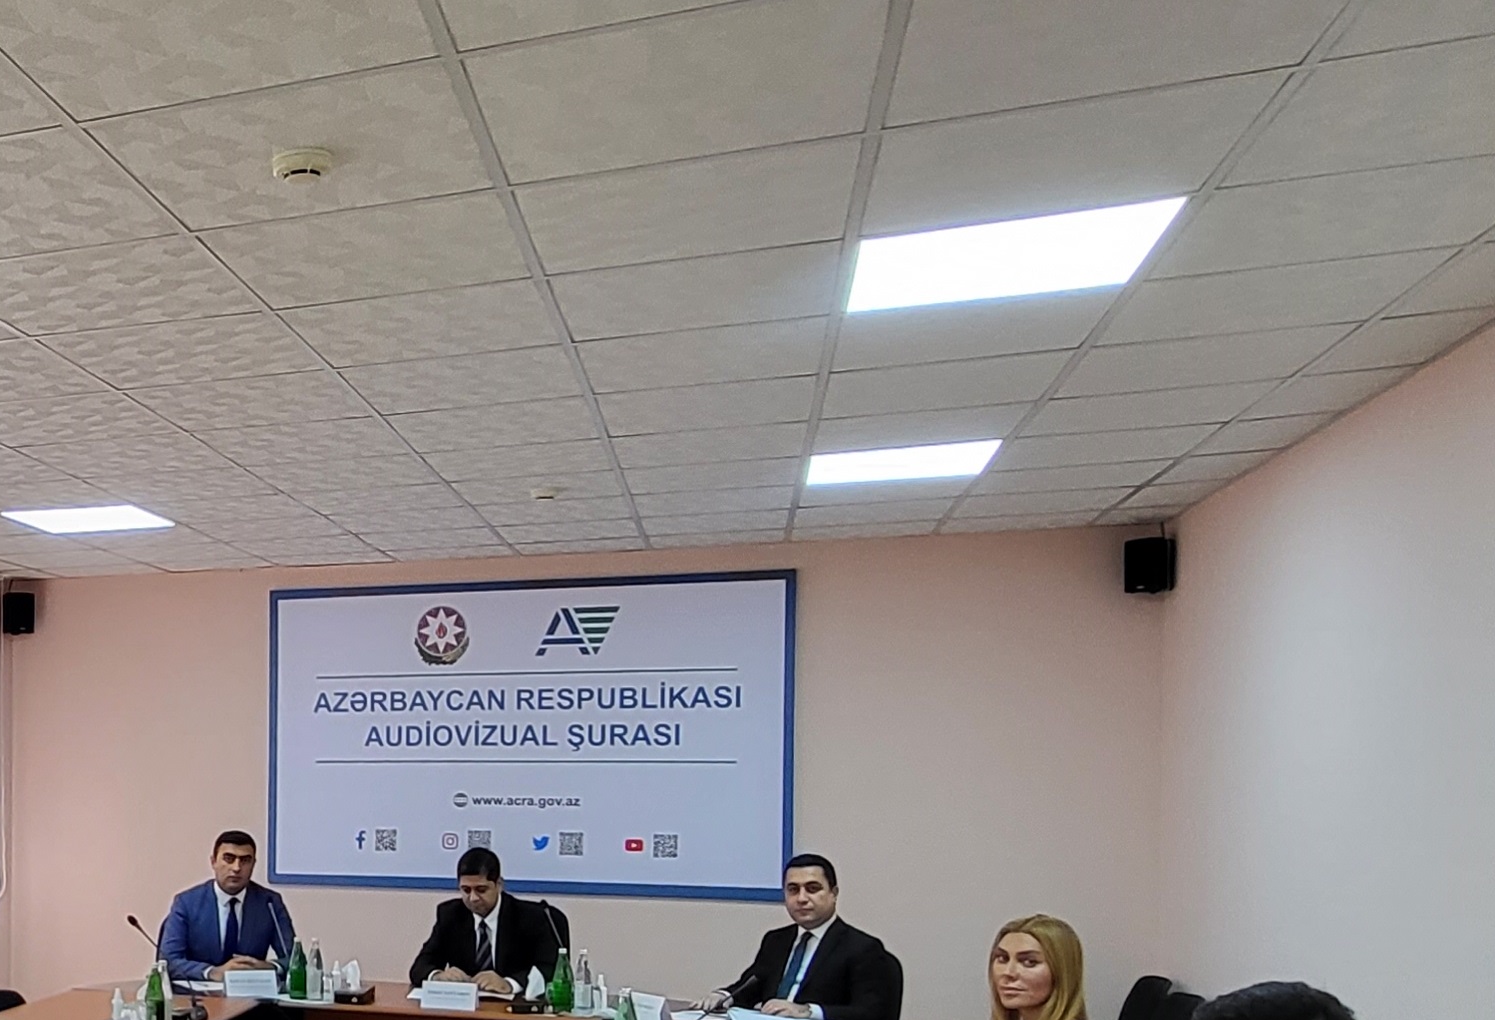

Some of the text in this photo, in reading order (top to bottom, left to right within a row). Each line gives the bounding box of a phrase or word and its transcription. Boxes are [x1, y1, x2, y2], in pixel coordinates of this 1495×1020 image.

[313, 682, 742, 713] AZƏRBAYCAN RESPUBLİKASI
[365, 720, 681, 751] AUDİOVİZUAL ŞURASI
[472, 797, 581, 808] www.acra.gov.az
